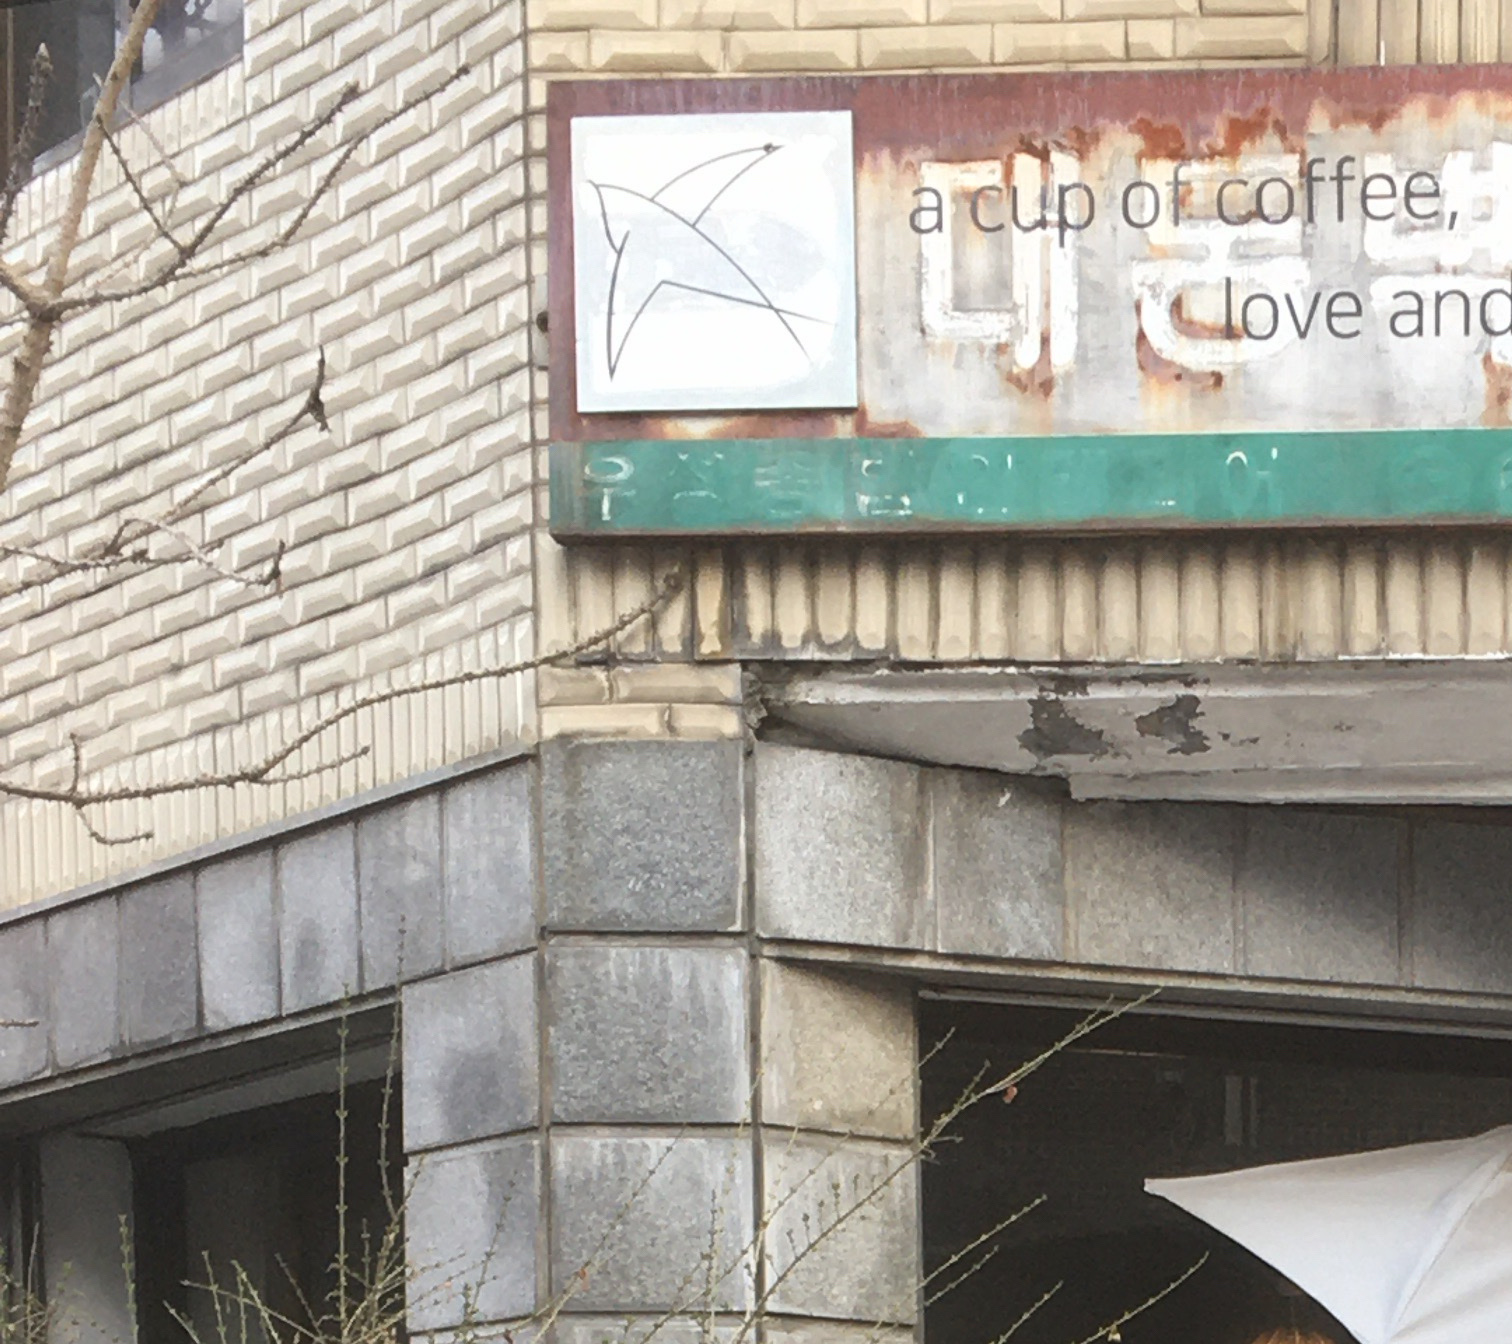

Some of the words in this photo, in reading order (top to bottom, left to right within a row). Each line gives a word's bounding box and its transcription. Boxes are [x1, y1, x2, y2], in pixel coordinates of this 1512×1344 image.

[908, 186, 945, 234] a
[969, 179, 1096, 248] cup
[1120, 162, 1194, 230] of
[1215, 154, 1460, 232] coffee,
[1223, 277, 1364, 341] love
